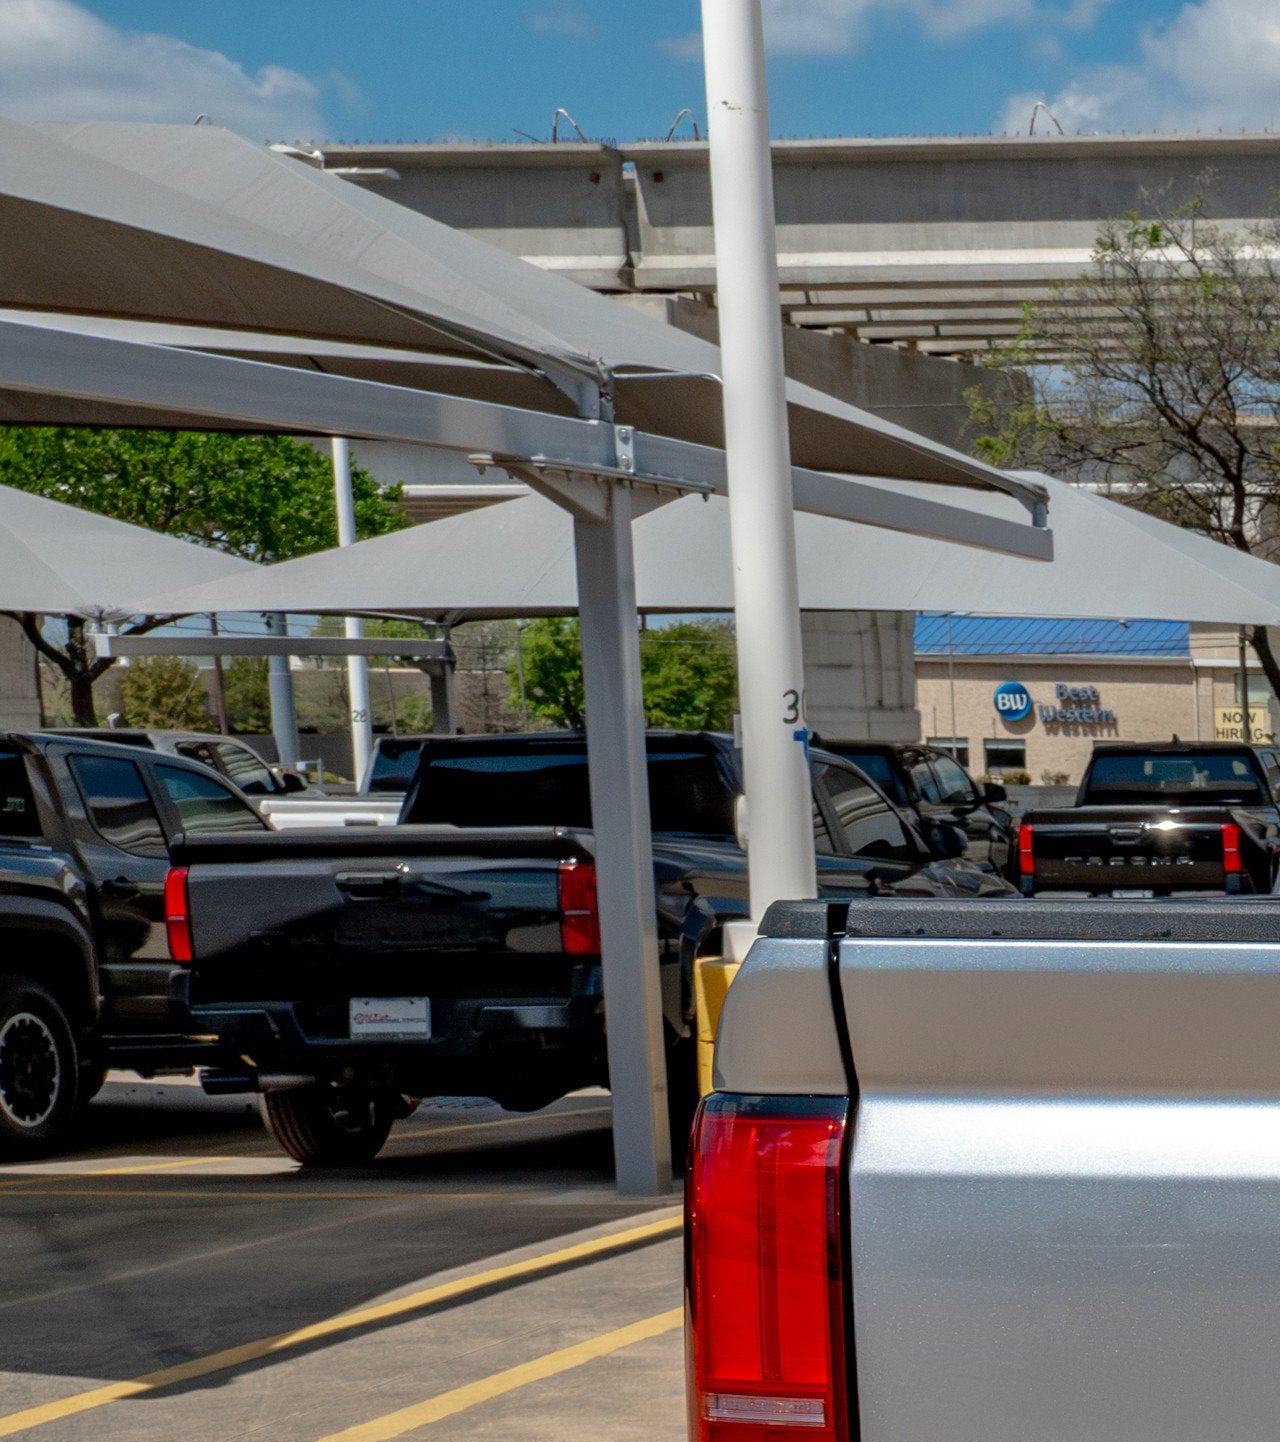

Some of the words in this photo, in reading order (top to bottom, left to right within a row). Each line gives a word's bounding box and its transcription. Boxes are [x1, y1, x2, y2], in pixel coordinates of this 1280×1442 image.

[1056, 684, 1098, 701] Best
[998, 693, 1027, 710] BW
[1038, 705, 1115, 723] Western
[1216, 728, 1264, 741] HIRIG
